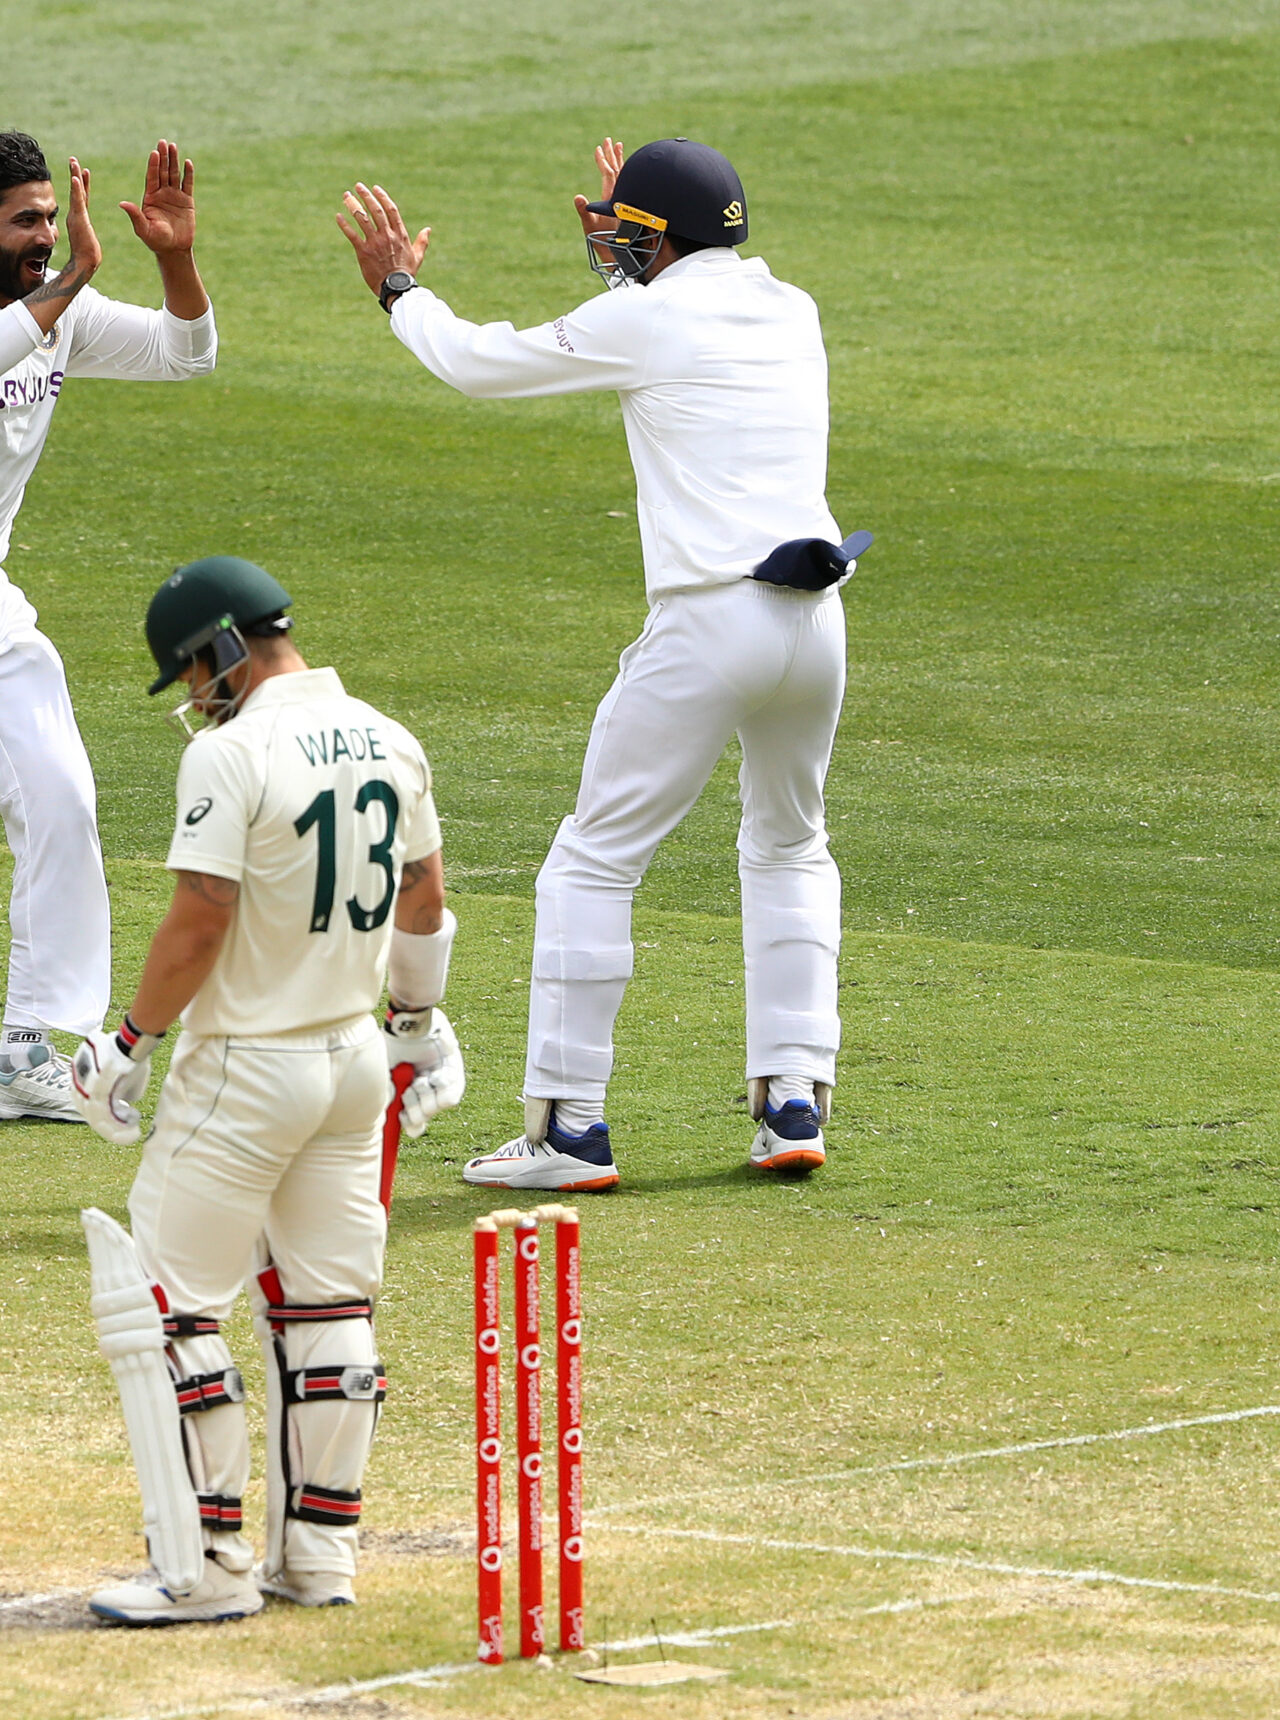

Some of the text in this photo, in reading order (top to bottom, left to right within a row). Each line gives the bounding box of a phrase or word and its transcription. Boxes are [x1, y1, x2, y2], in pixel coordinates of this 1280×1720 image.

[295, 727, 387, 768] WADE
[292, 778, 399, 934] 13
[483, 1256, 497, 1326] vodafone
[526, 1263, 540, 1333] vodafone
[565, 1246, 580, 1316] vodafone
[483, 1365, 498, 1435] vodafone
[527, 1372, 541, 1442] vodafone
[567, 1356, 581, 1425] vodafone
[484, 1474, 499, 1544] vodafone
[529, 1480, 542, 1551] vodafone
[567, 1464, 582, 1534] vodafone
